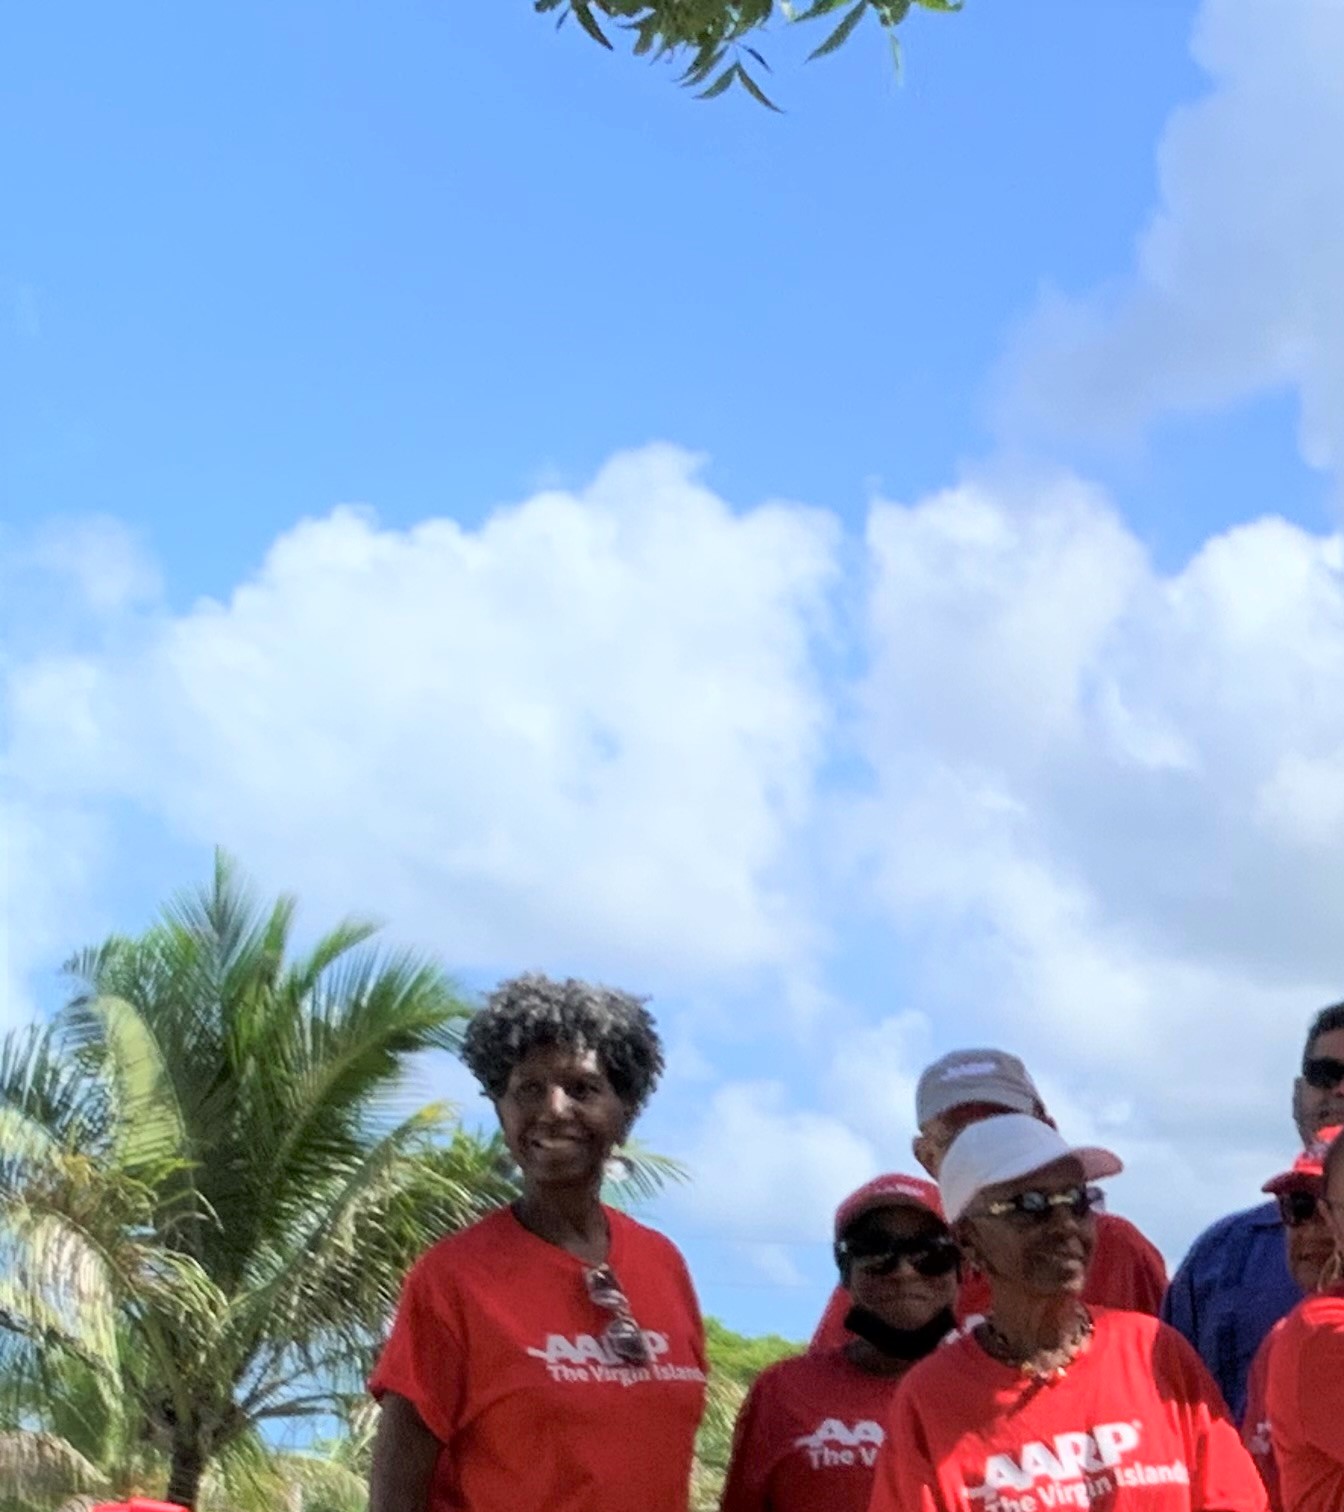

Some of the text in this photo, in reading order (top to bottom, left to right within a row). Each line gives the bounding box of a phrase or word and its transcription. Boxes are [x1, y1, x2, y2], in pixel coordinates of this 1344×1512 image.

[546, 1362, 590, 1383] The
[587, 1362, 652, 1387] Virgin
[807, 1447, 855, 1470] The
[968, 1421, 1140, 1499] AARP
[1035, 1473, 1114, 1509] Virgin
